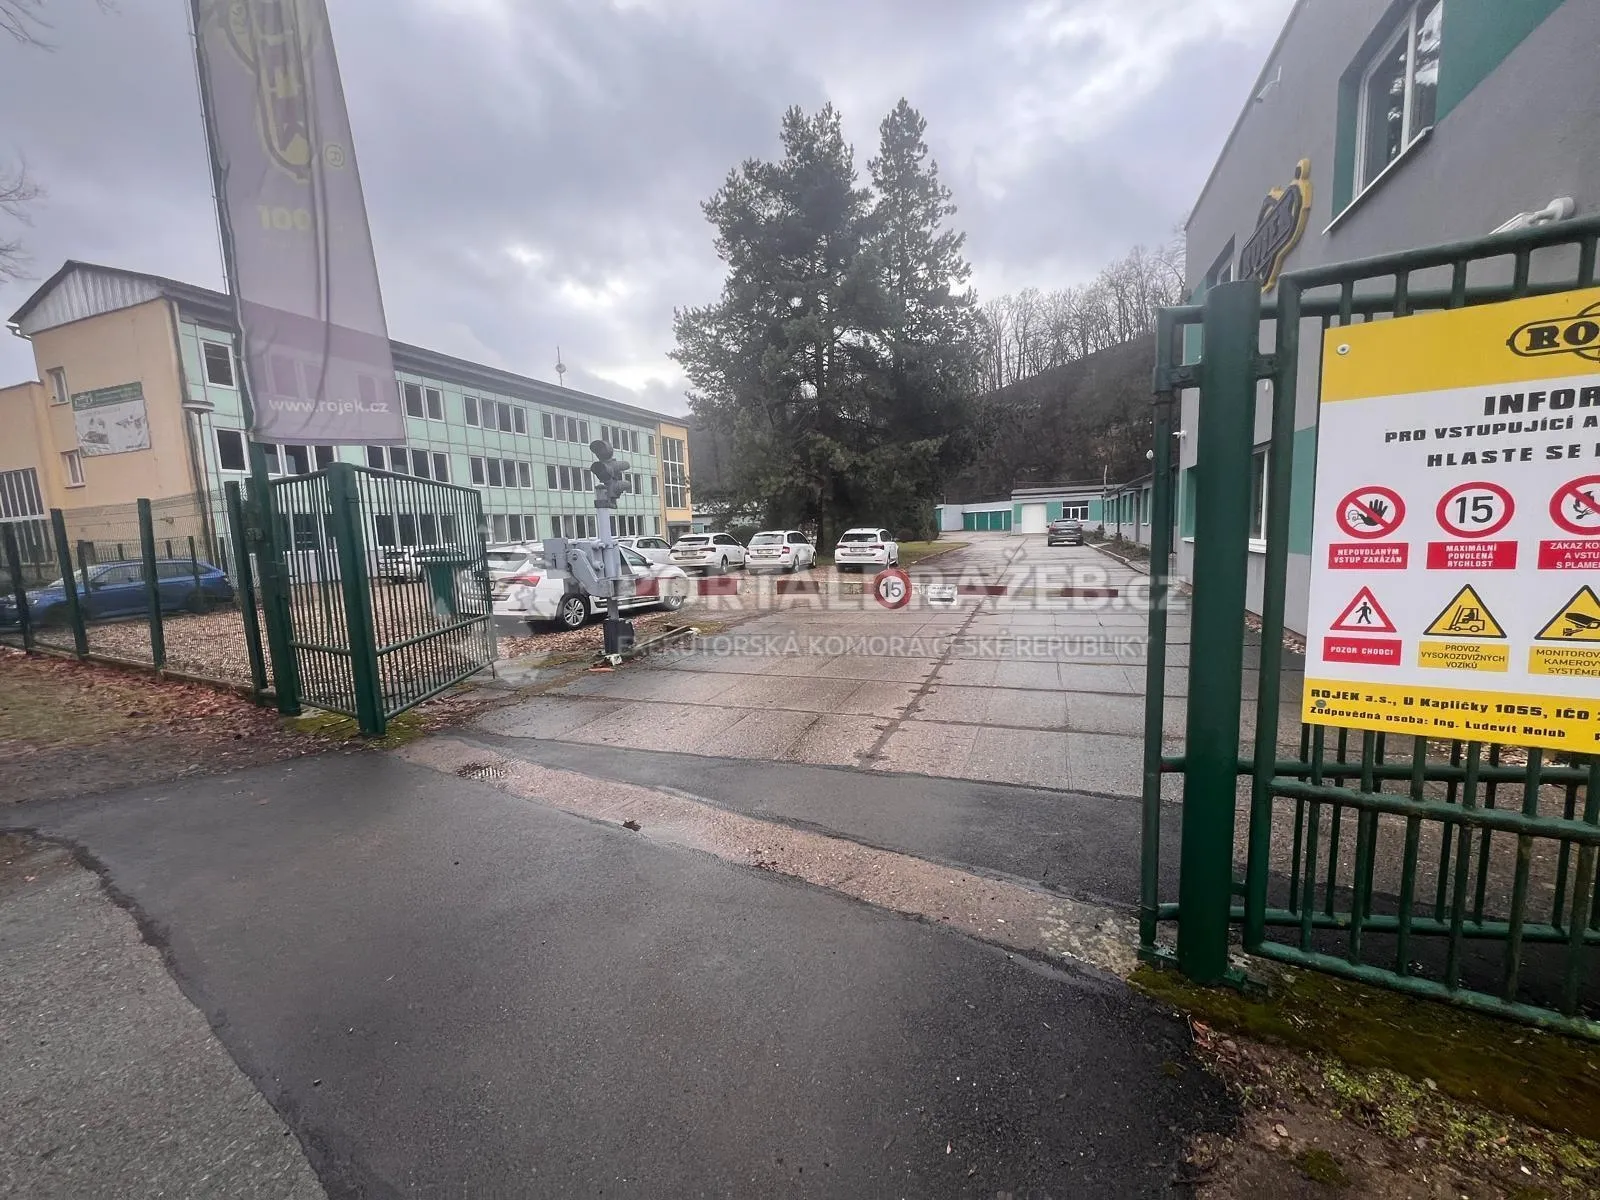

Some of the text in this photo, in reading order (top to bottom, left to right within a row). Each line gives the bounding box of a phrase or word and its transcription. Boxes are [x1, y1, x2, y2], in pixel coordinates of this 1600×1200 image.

[268, 398, 390, 415] www.rojek.cz
[1385, 415, 1598, 443] PRO VSTUPUJÍCÍ A
[1427, 447, 1533, 467] HLASTE
[1545, 444, 1581, 460] SE
[1455, 495, 1494, 524] 15
[1446, 543, 1497, 552] MAXIMÁLNÍ
[1550, 541, 1600, 550] ZÁKAZ KO
[1337, 548, 1400, 556] NEPOVOLANÝM
[1448, 551, 1494, 560] POVOLENÁ
[1564, 552, 1572, 560] A
[1334, 555, 1402, 564] VSTUP ZAKÁZÁN
[1447, 560, 1493, 568] RYCHLOST
[1556, 561, 1600, 570] S PLAME
[882, 581, 902, 598] 15
[1331, 646, 1394, 656] POZOR CHODCI
[1445, 644, 1480, 653] PROVOZ
[1536, 649, 1600, 659] MONITOROV
[1548, 667, 1600, 677] SYSTÉME
[1311, 689, 1360, 701] ROJEK
[1403, 696, 1414, 706] U
[1420, 698, 1489, 713] Kapličky
[1495, 704, 1548, 719] 1055,
[1556, 707, 1590, 720] IČO
[1310, 706, 1381, 720] Zodpovědná
[1386, 715, 1428, 725] osoba:
[1433, 718, 1460, 729] Ing.
[1523, 726, 1566, 738] Holub
